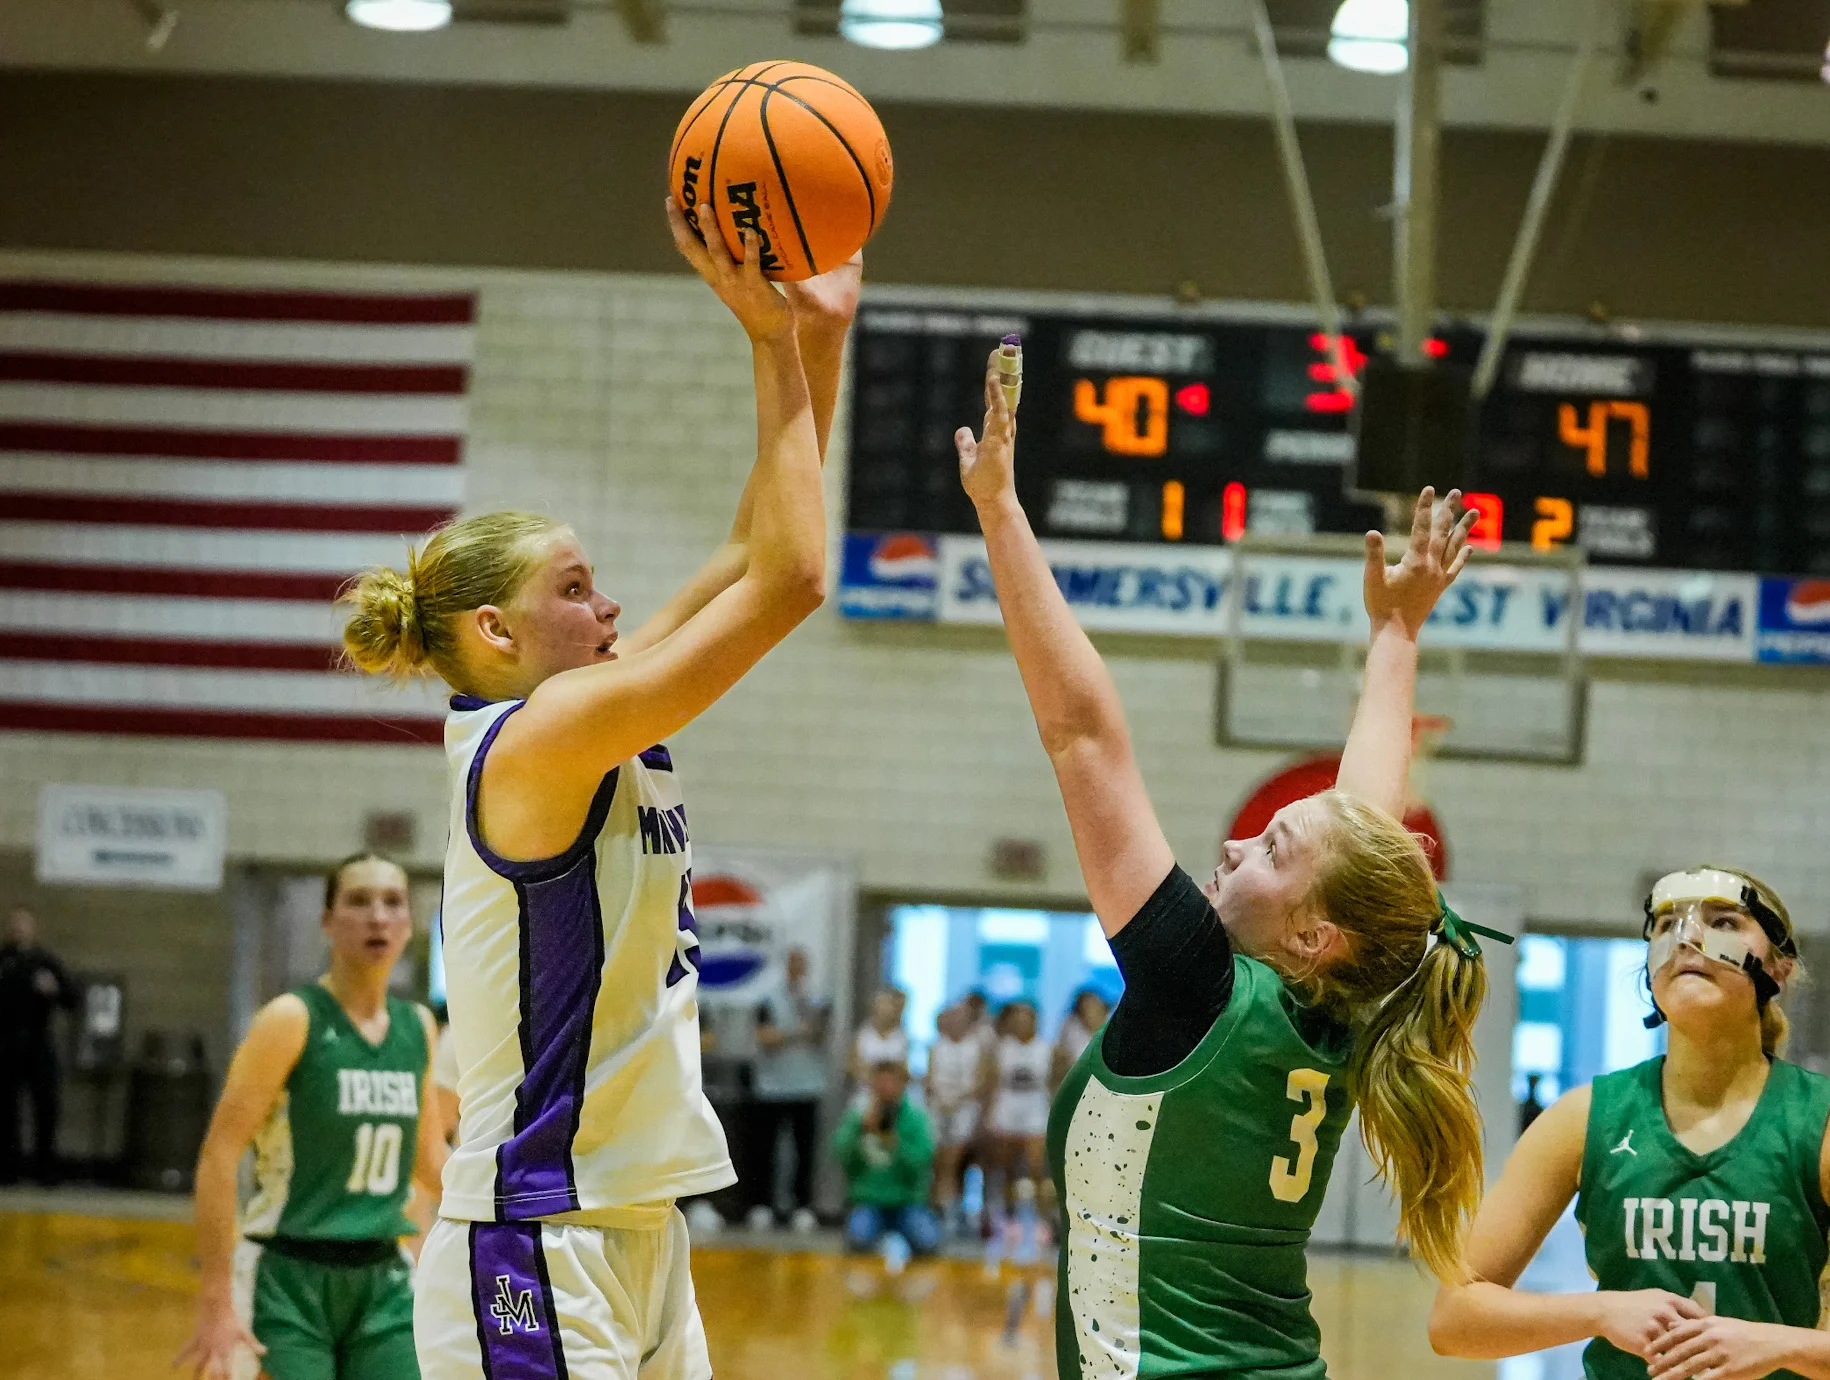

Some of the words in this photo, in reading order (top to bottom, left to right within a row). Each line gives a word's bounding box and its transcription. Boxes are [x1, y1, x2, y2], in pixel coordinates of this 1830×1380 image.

[1073, 376, 1169, 456] 40
[1558, 400, 1649, 479] 47
[1161, 479, 1185, 540] 1
[1222, 481, 1247, 541] 1
[1531, 496, 1574, 552] 2
[337, 1069, 418, 1116] IRISH
[345, 1122, 403, 1196] 10
[1269, 1068, 1331, 1203] 3
[1623, 1197, 1770, 1264] IRISH
